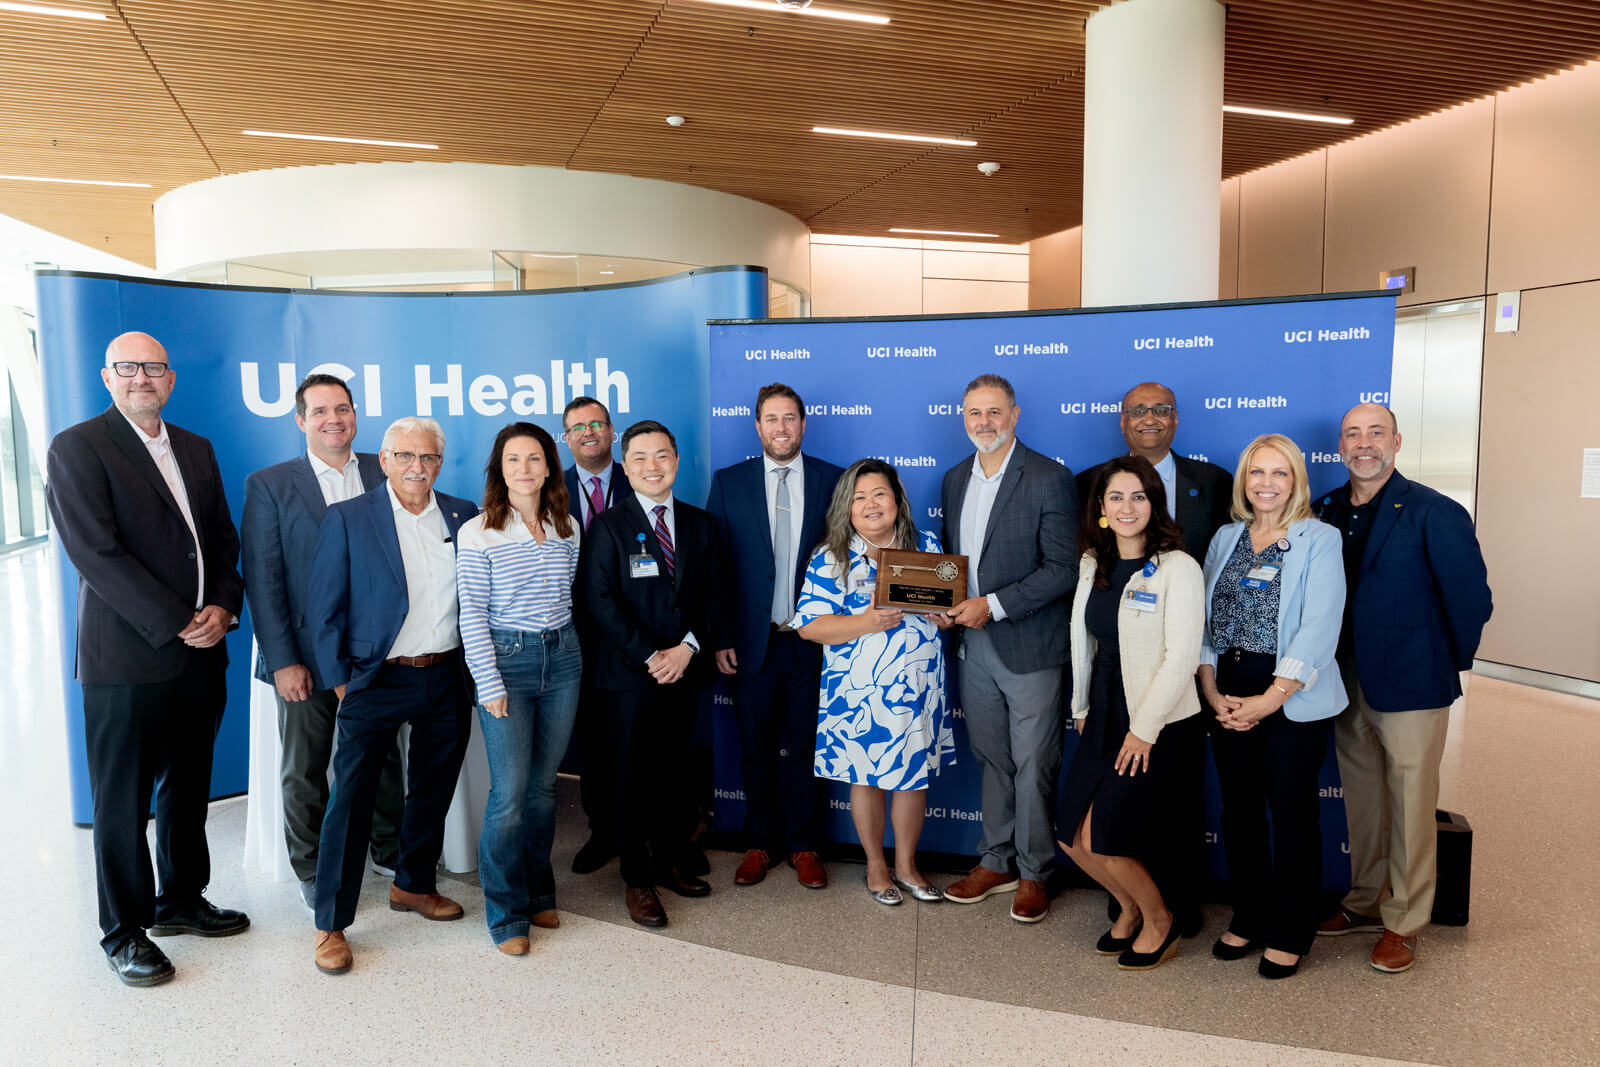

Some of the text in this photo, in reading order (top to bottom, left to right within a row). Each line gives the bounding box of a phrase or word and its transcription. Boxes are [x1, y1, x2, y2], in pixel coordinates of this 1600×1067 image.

[1284, 327, 1370, 344] UCI Health
[994, 342, 1069, 356] UCI Health
[1134, 335, 1214, 351] UCI Health
[745, 348, 811, 361] UCI Health
[867, 346, 937, 358] UCI Health
[414, 358, 630, 417] Health
[1204, 395, 1287, 410] UCI Health
[1359, 391, 1388, 404] UCI
[712, 405, 751, 417] Health
[806, 404, 872, 416] UCI Health
[928, 404, 952, 416] UCI
[1060, 401, 1122, 415] UCI Heal
[894, 456, 936, 467] Health
[1311, 451, 1343, 463] Hea
[927, 507, 944, 518] UC
[1065, 719, 1078, 730] CI
[714, 788, 747, 801] Healt
[830, 799, 851, 810] Hea
[924, 807, 984, 822] UCI Healt
